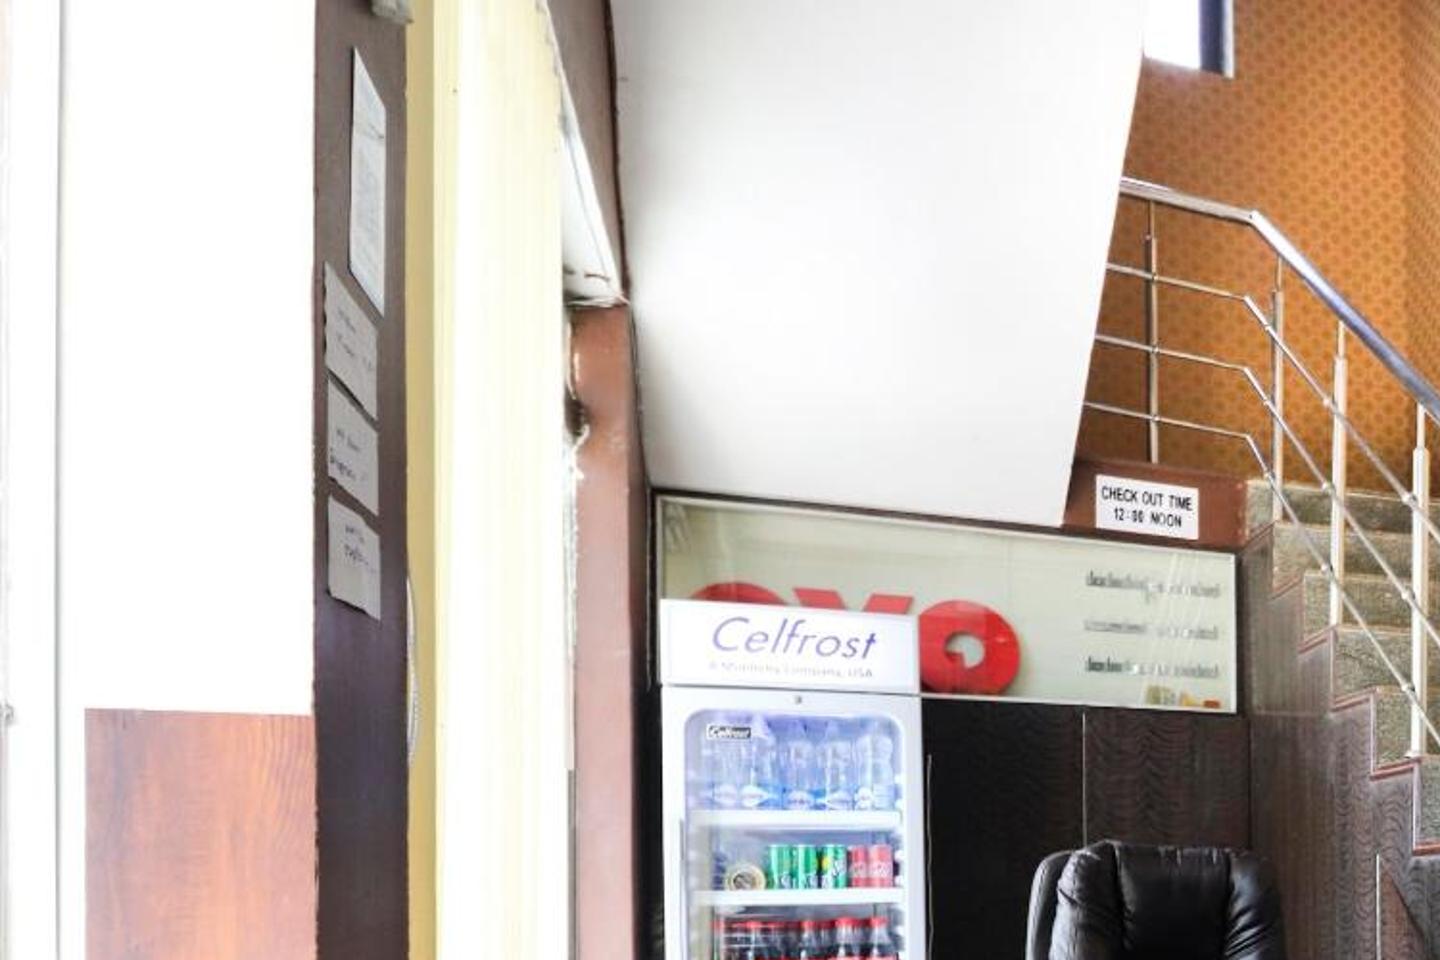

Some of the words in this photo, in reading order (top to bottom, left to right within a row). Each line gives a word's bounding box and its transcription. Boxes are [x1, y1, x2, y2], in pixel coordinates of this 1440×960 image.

[1102, 486, 1137, 502] CHECK
[1142, 491, 1163, 506] OUT
[1168, 495, 1193, 511] TIME
[1151, 511, 1182, 527] NOON
[712, 616, 876, 659] Celfrost
